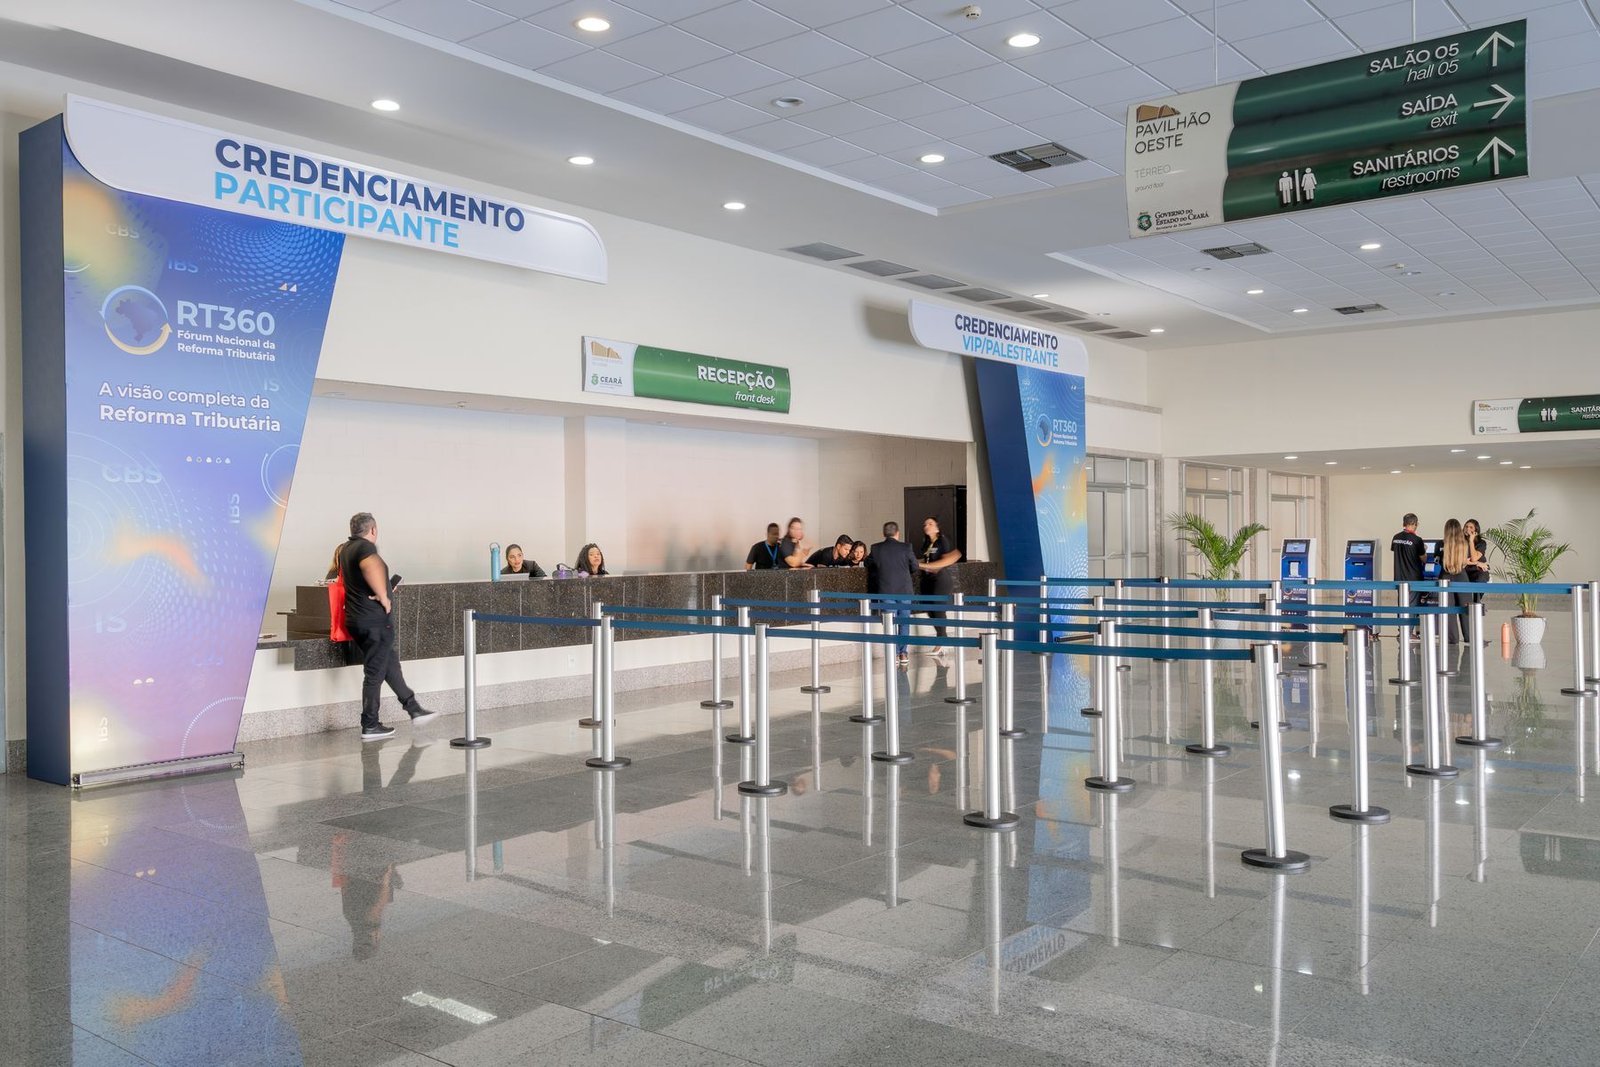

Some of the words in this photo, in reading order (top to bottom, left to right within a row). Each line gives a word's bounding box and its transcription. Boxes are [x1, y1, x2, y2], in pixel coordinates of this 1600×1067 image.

[1369, 44, 1430, 74] SALÃO
[1435, 43, 1459, 60] 05
[1406, 64, 1433, 82] hall
[1437, 59, 1459, 76] 05
[1402, 94, 1458, 116] SAÍDA
[1135, 111, 1211, 138] PAVILHÃO
[1430, 111, 1458, 129] exit
[1135, 133, 1183, 154] OESTE
[1135, 164, 1172, 179] TÉRREO
[1353, 145, 1460, 176] SANITÁRIOS
[215, 138, 525, 232] CREDENCIAMENTO
[1382, 166, 1460, 189] restrooms
[215, 172, 459, 248] PARTICIPANTE
[1155, 209, 1185, 219] GOVERNO
[1156, 217, 1179, 226] ESTADO
[1188, 211, 1209, 221] CEARÁ
[105, 223, 140, 239] CBS
[177, 300, 276, 336] RT360
[177, 329, 213, 343] Fórum
[215, 334, 261, 348] Nacional
[263, 340, 276, 350] da
[955, 313, 1059, 350] CREDENCIAMENTO
[177, 342, 223, 356] Reforma
[226, 347, 276, 362] Tributária
[962, 335, 1059, 367] VIP/PALESTRANTE
[262, 379, 280, 392] IS
[600, 376, 623, 385] CEARÁ
[697, 365, 776, 391] RECEPÇÃO
[99, 382, 113, 397] A
[116, 384, 164, 401] visão
[167, 389, 246, 407] completa
[250, 394, 270, 409] da
[735, 390, 755, 403] front
[756, 394, 776, 405] desk
[99, 403, 187, 426] Reforma
[191, 411, 281, 432] Tributária
[1052, 418, 1078, 434] RT360
